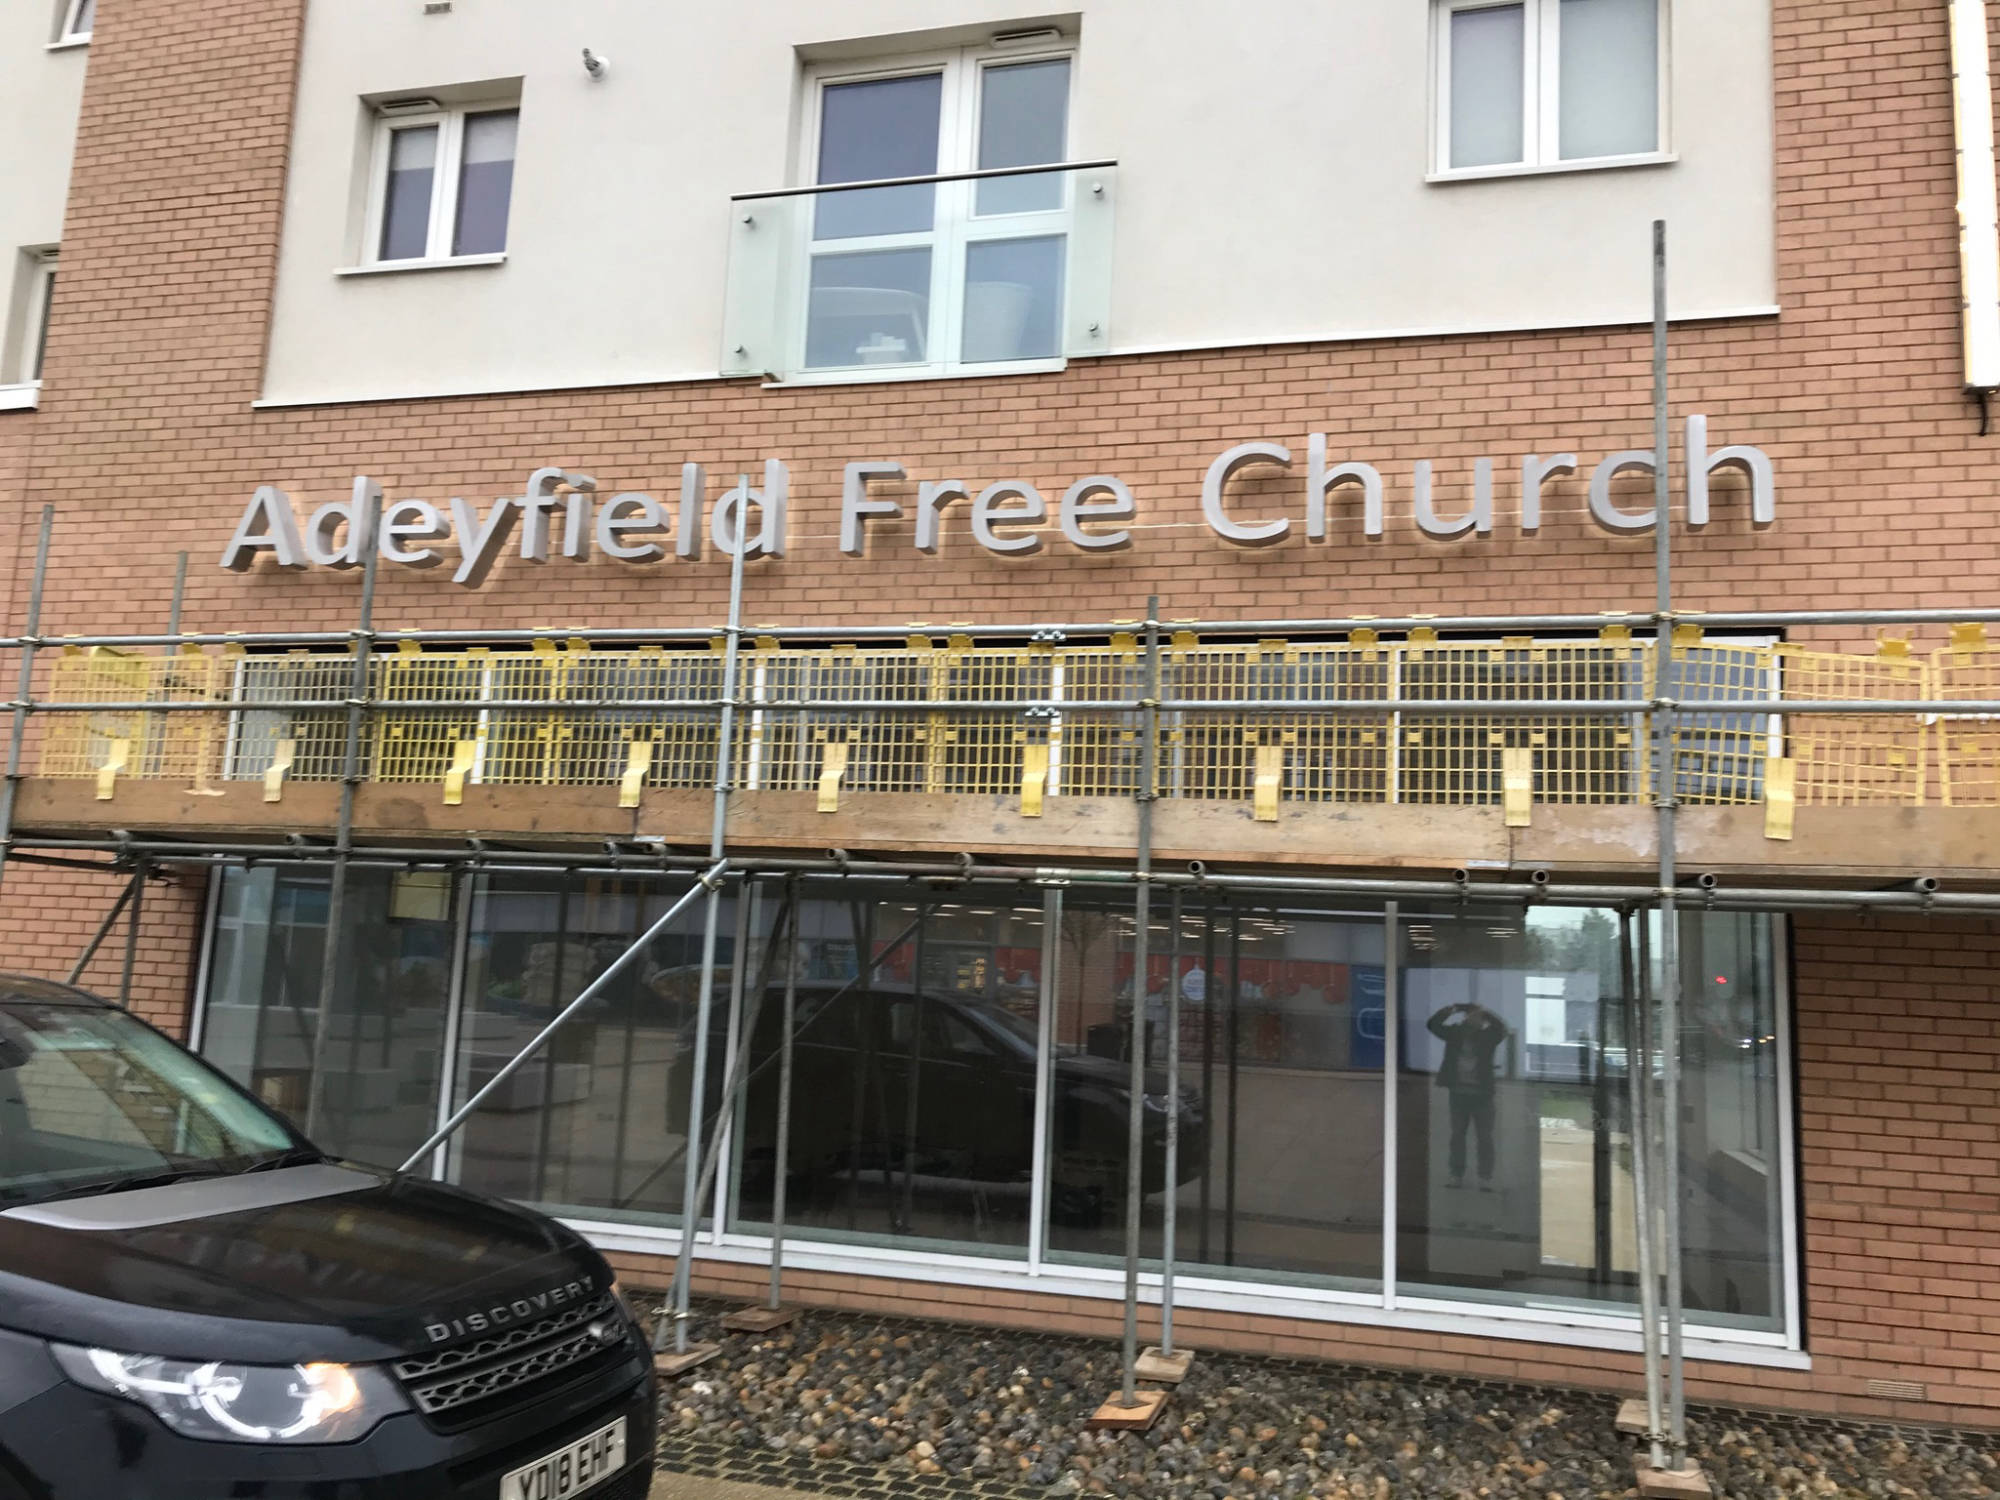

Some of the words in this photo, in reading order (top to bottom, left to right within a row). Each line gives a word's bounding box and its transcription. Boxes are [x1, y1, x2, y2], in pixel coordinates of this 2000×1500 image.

[219, 458, 789, 590] Adeyfield
[839, 461, 1136, 556] Free
[1202, 414, 1776, 542] Church
[424, 1275, 595, 1342] DISCOVERY
[519, 1453, 570, 1500] YD18
[578, 1428, 616, 1485] EHF
